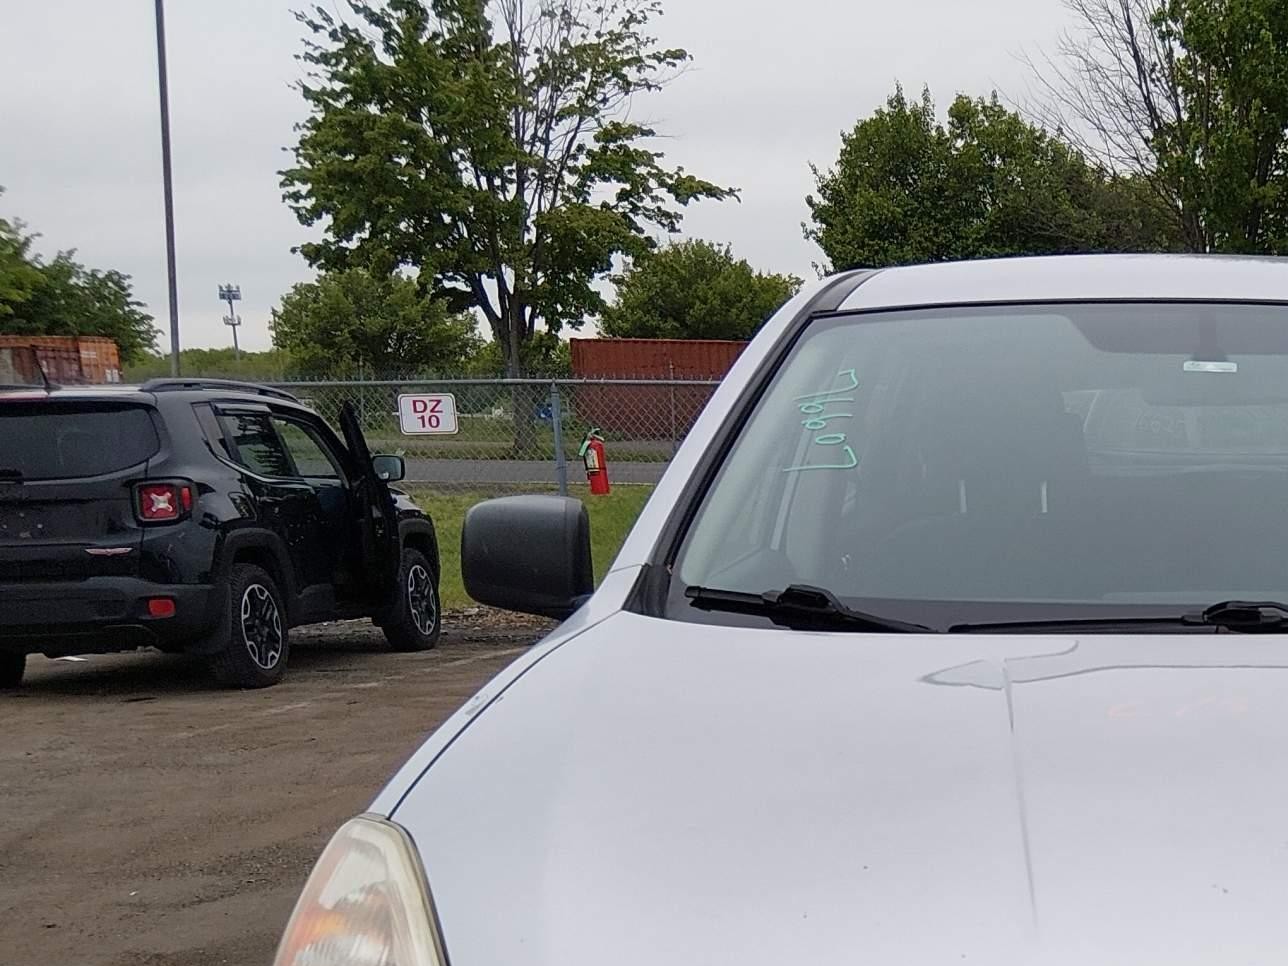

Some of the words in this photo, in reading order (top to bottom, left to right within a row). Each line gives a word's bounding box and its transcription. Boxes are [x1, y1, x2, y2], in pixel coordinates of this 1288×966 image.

[412, 399, 444, 414] DZ
[417, 414, 441, 429] 10
[782, 368, 859, 472] 76607
